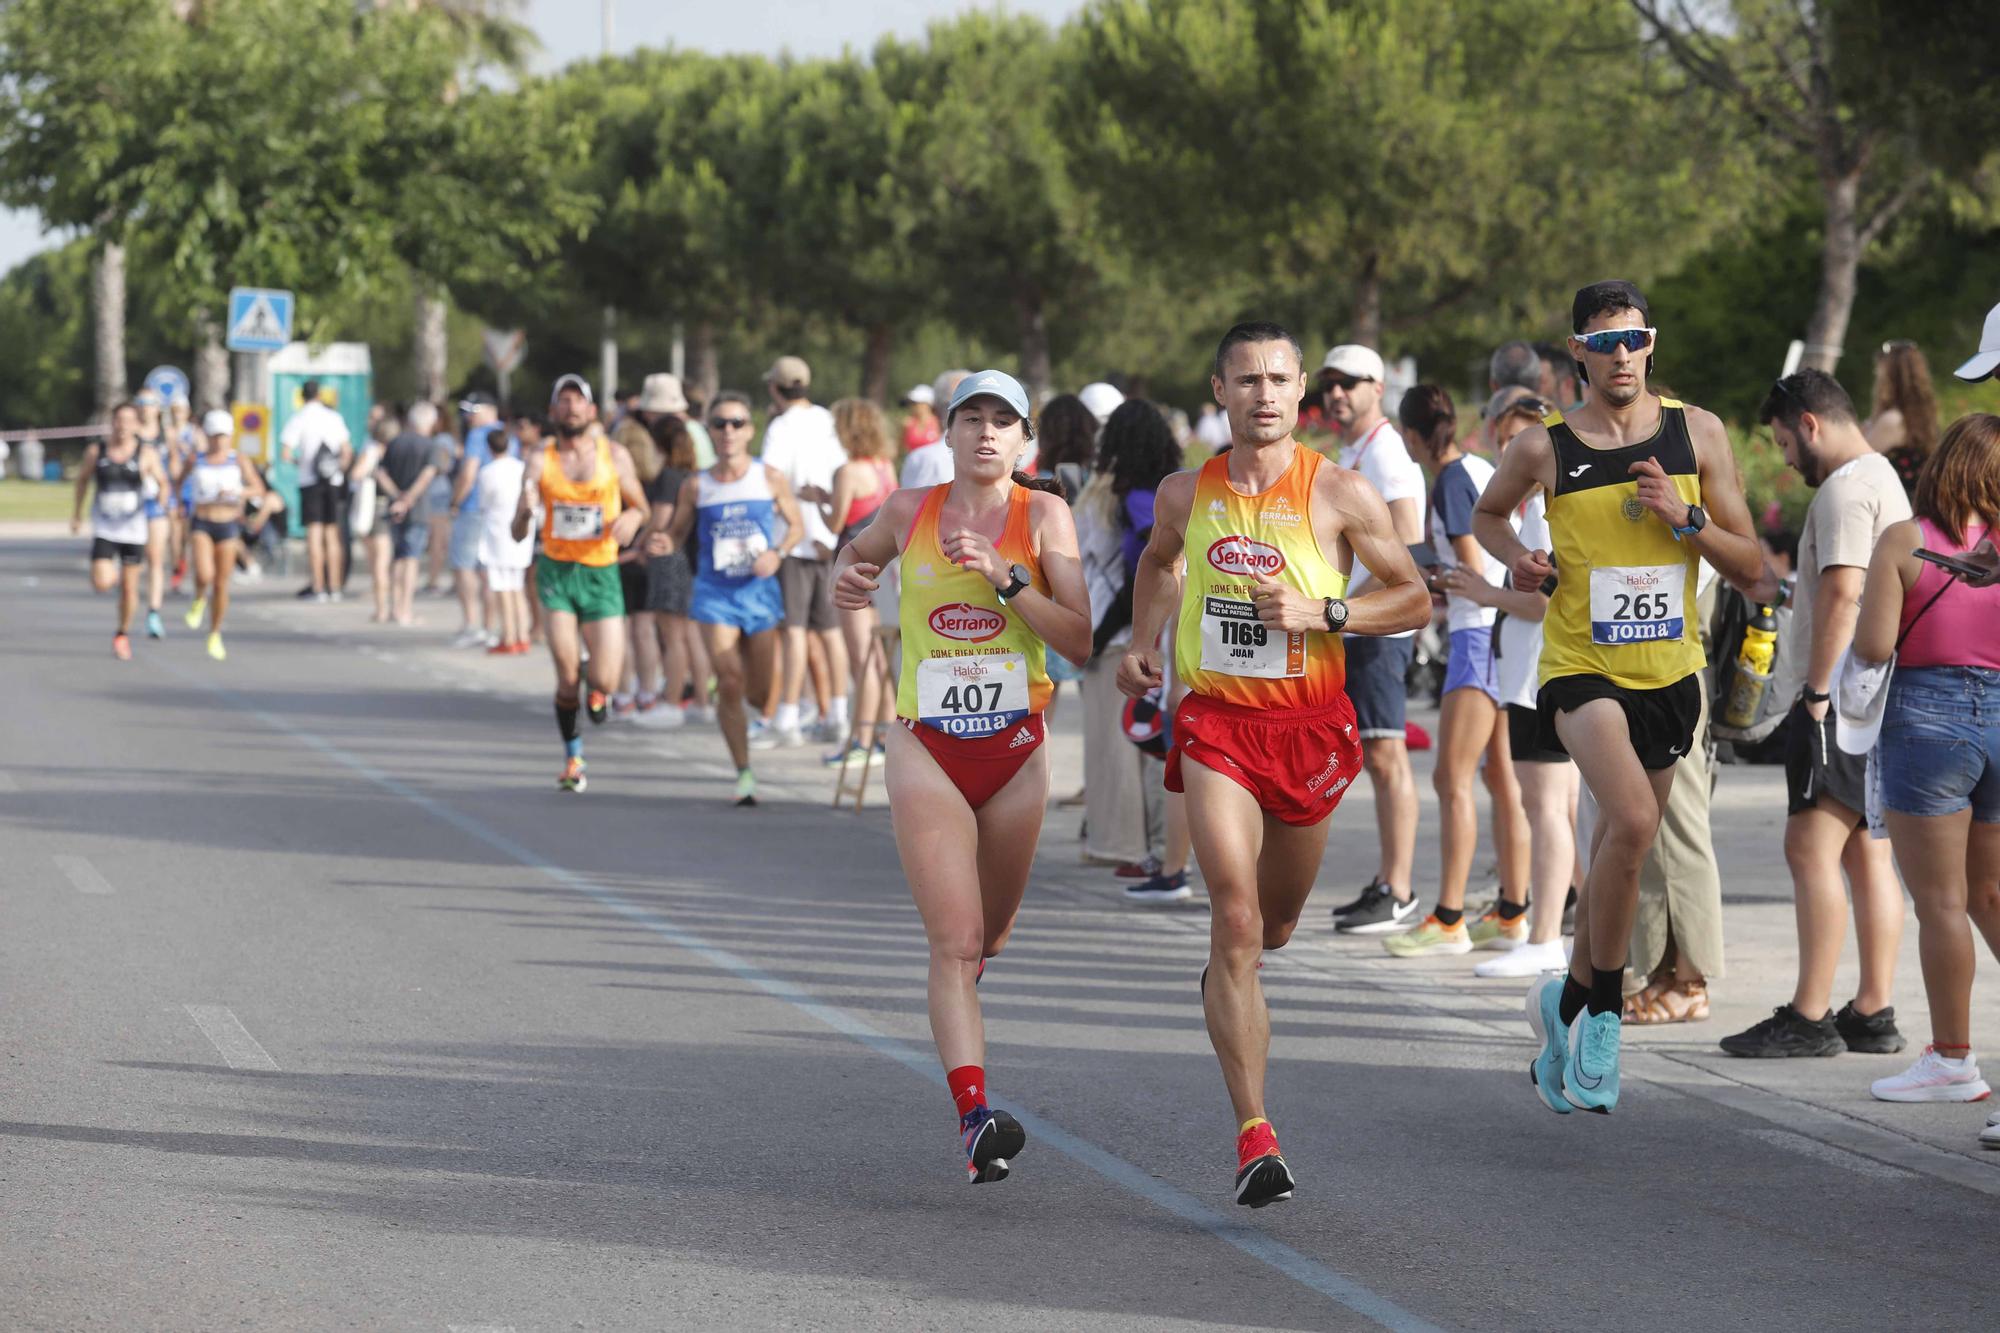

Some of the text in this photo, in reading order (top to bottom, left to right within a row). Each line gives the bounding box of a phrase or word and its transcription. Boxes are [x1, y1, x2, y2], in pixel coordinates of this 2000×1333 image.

[1259, 511, 1302, 522] SERRANO
[1213, 545, 1279, 568] Serrano
[1210, 584, 1230, 594] COME
[1229, 609, 1254, 617] PATERNA
[1613, 592, 1668, 620] 265
[936, 613, 1000, 631] Serrano
[1220, 620, 1268, 647] 1169
[930, 647, 1011, 659] COME BIEN Y CORRE
[1229, 648, 1254, 659] JUAN
[941, 682, 1003, 714] 407
[1009, 734, 1036, 749] adidas
[1306, 761, 1339, 791] Paterna
